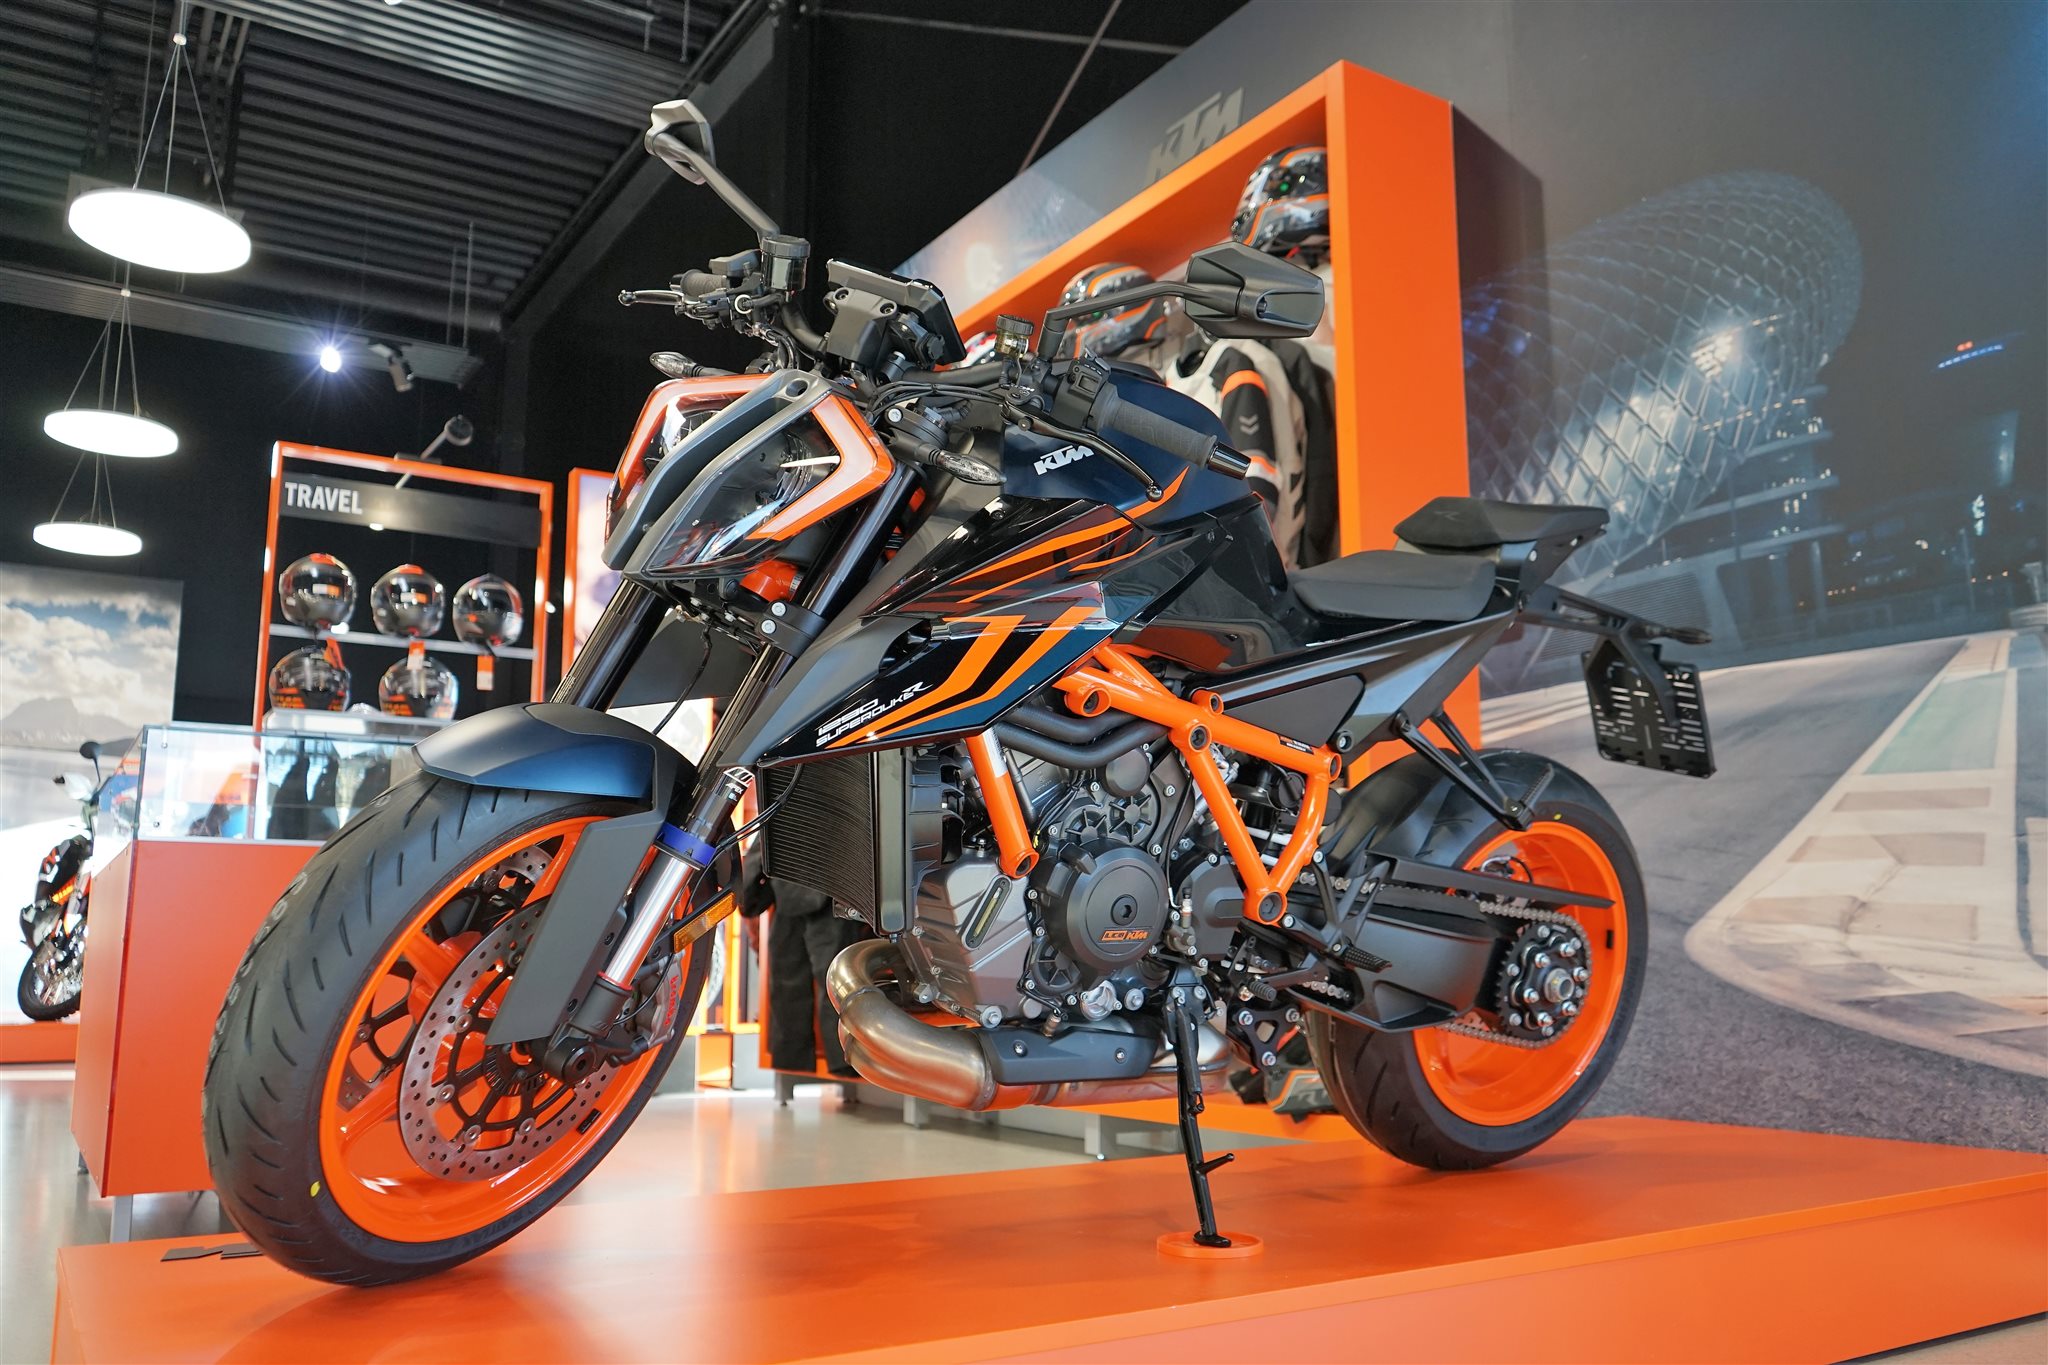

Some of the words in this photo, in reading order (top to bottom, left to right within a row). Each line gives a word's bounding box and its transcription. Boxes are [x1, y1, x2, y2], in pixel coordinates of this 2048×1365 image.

[1144, 87, 1244, 186] KTM
[1033, 445, 1095, 476] KTM
[284, 481, 363, 515] TRAVEL
[818, 698, 878, 736] 1290
[1126, 930, 1149, 940] KTM
